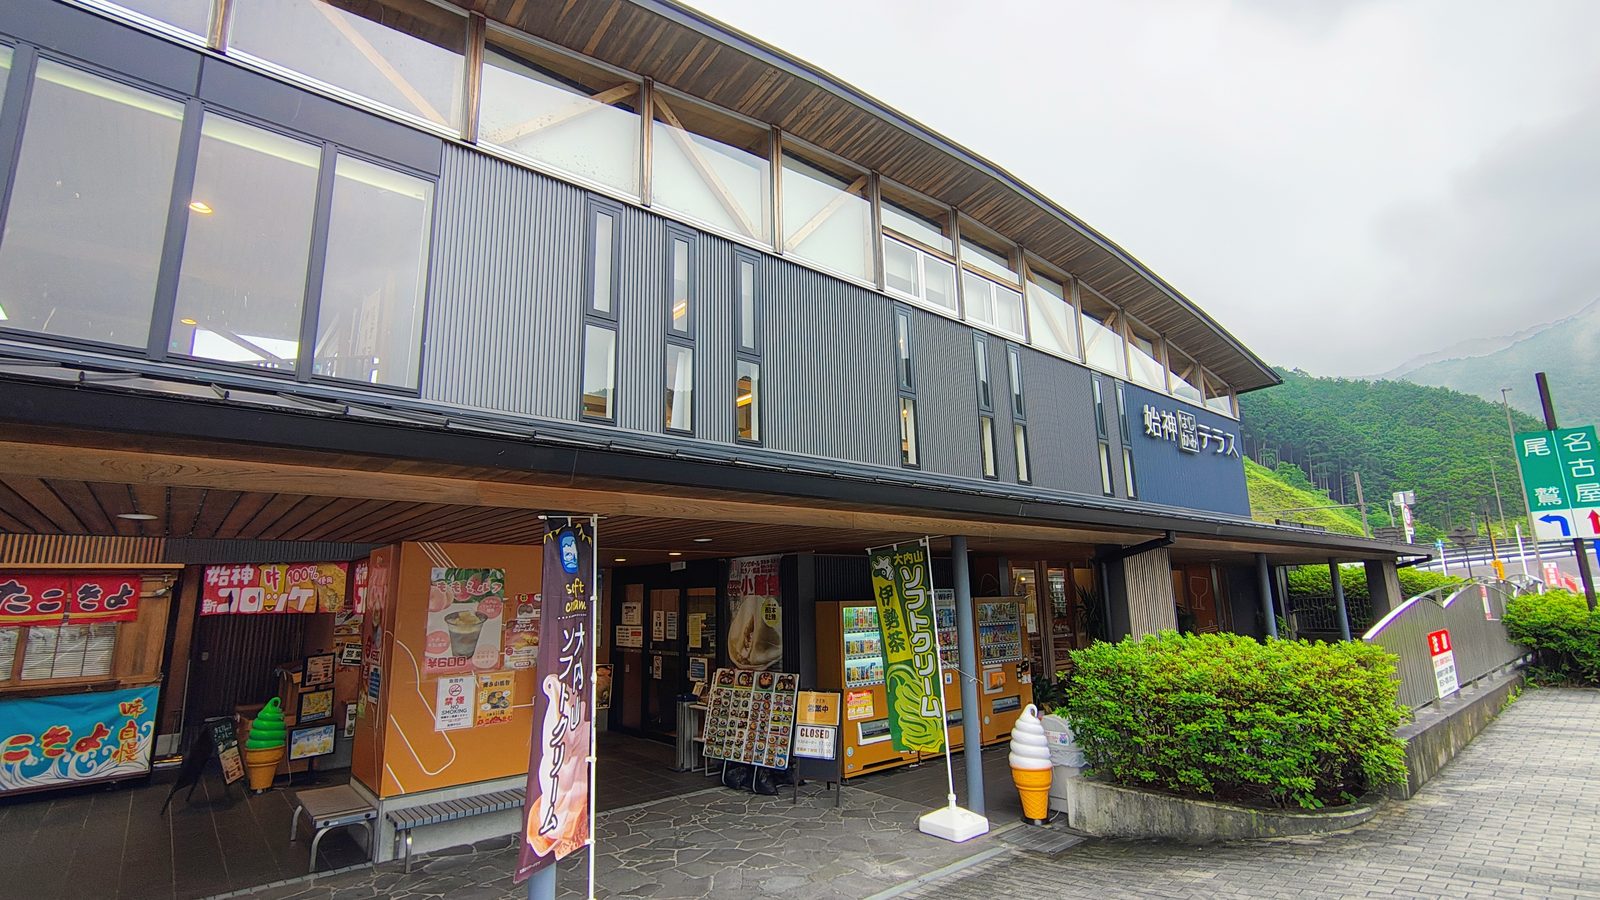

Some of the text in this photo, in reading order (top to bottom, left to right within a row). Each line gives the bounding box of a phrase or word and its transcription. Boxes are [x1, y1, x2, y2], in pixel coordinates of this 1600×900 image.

[1143, 404, 1178, 441] 始神
[1523, 437, 1562, 506] 尾鷲
[1562, 432, 1600, 503] 名古屋
[893, 550, 924, 566] 大内山
[207, 566, 254, 586] 始神
[287, 564, 320, 585] 100%
[217, 587, 315, 613] コロッケ
[878, 585, 906, 654] 伊勢茶
[901, 565, 942, 719] ソフトクリーム
[427, 656, 467, 668] ¥600
[441, 708, 468, 716] SMOKING
[112, 697, 148, 764] 味自慢
[539, 626, 575, 836] ソフトクリーム
[800, 727, 830, 740] CLOSED
